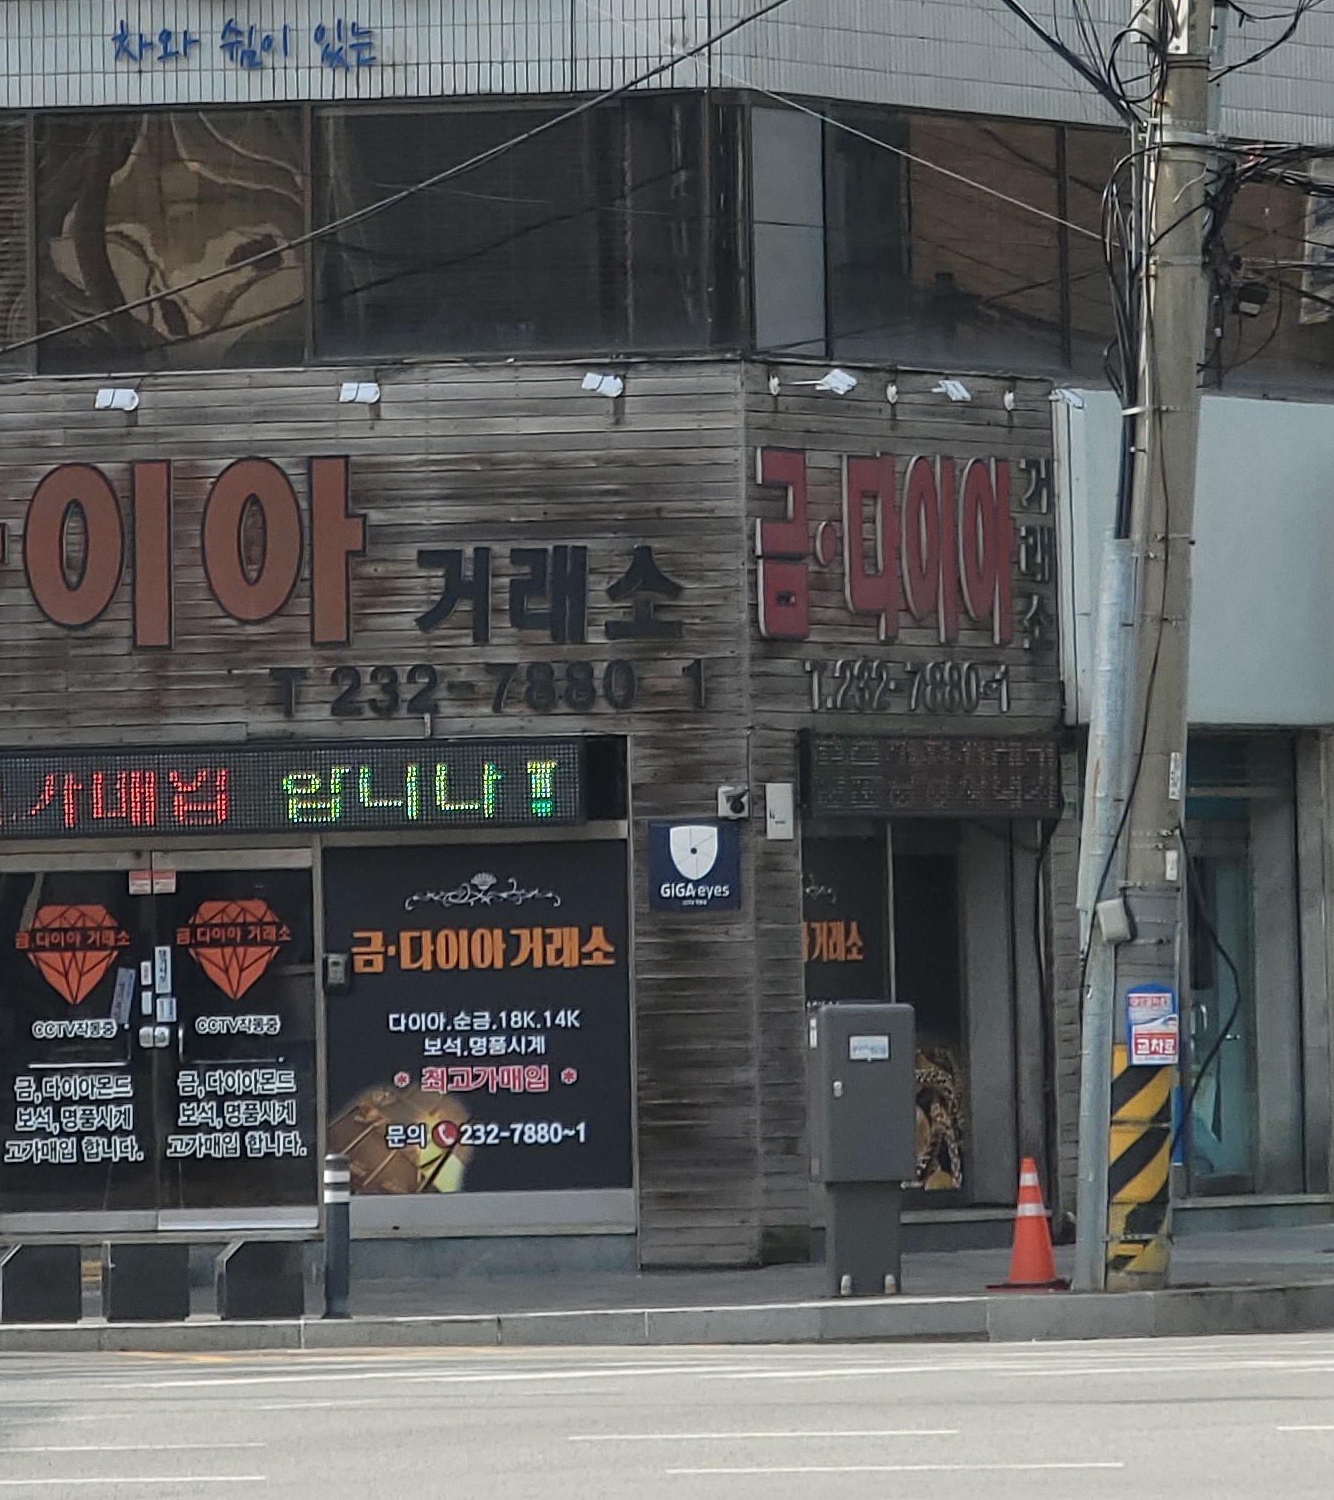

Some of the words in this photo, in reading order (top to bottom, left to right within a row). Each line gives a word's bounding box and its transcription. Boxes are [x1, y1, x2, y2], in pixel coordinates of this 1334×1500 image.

[111, 19, 200, 62] 차와
[219, 18, 290, 70] 쉼이
[313, 18, 377, 72] 있는
[413, 544, 685, 644] 거래소
[330, 658, 638, 716] 232-7880
[510, 926, 616, 969] 거래소
[1136, 1037, 1175, 1055] 교차로
[420, 1065, 549, 1095] 최고가매입
[3, 1136, 77, 1164] 고가매입
[83, 1136, 145, 1163] 합니다.
[167, 1132, 240, 1159] 고가매입
[245, 1131, 308, 1158] 합니다.
[385, 1124, 427, 1148] 문의
[460, 1122, 587, 1145] 232-7880~1
